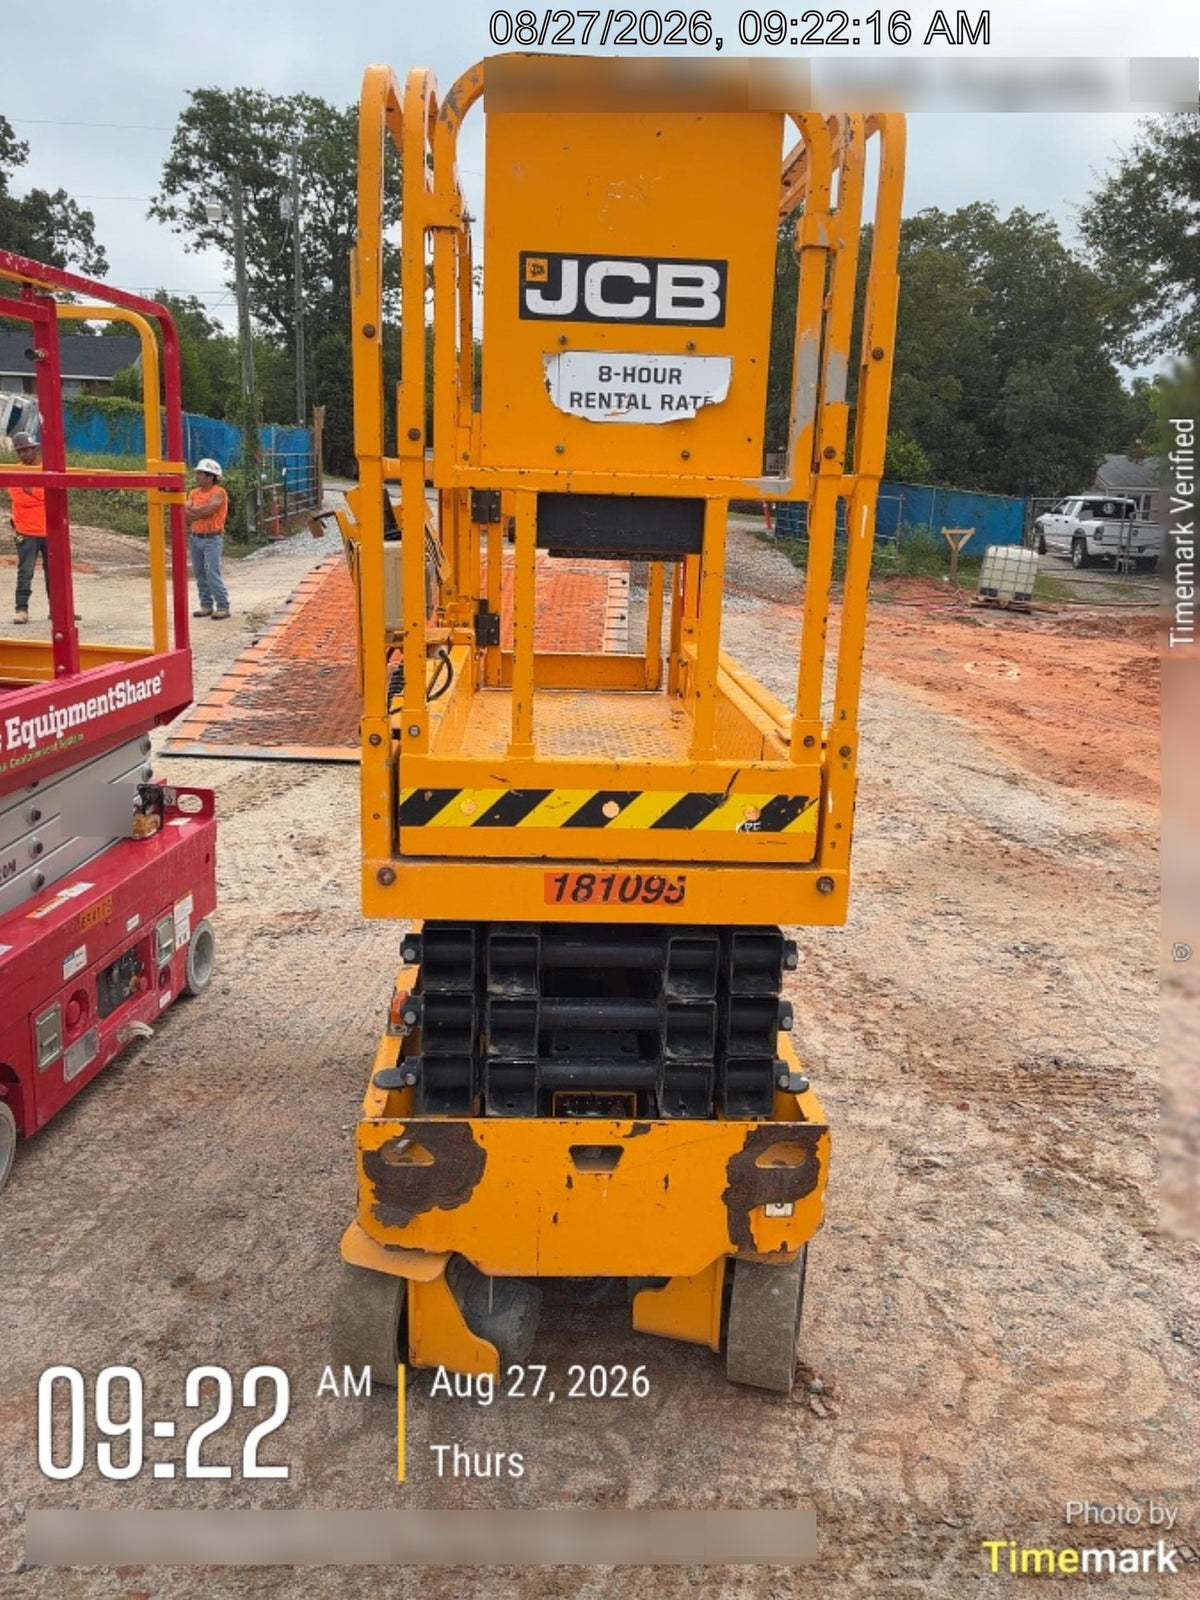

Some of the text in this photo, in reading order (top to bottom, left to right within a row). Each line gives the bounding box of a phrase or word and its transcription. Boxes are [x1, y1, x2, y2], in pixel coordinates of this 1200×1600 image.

[526, 258, 722, 321] JCB
[598, 365, 682, 385] 8-HOUR
[570, 392, 651, 411] RENTAL
[5, 677, 162, 750] EquipmentShare
[554, 873, 686, 904] 181095
